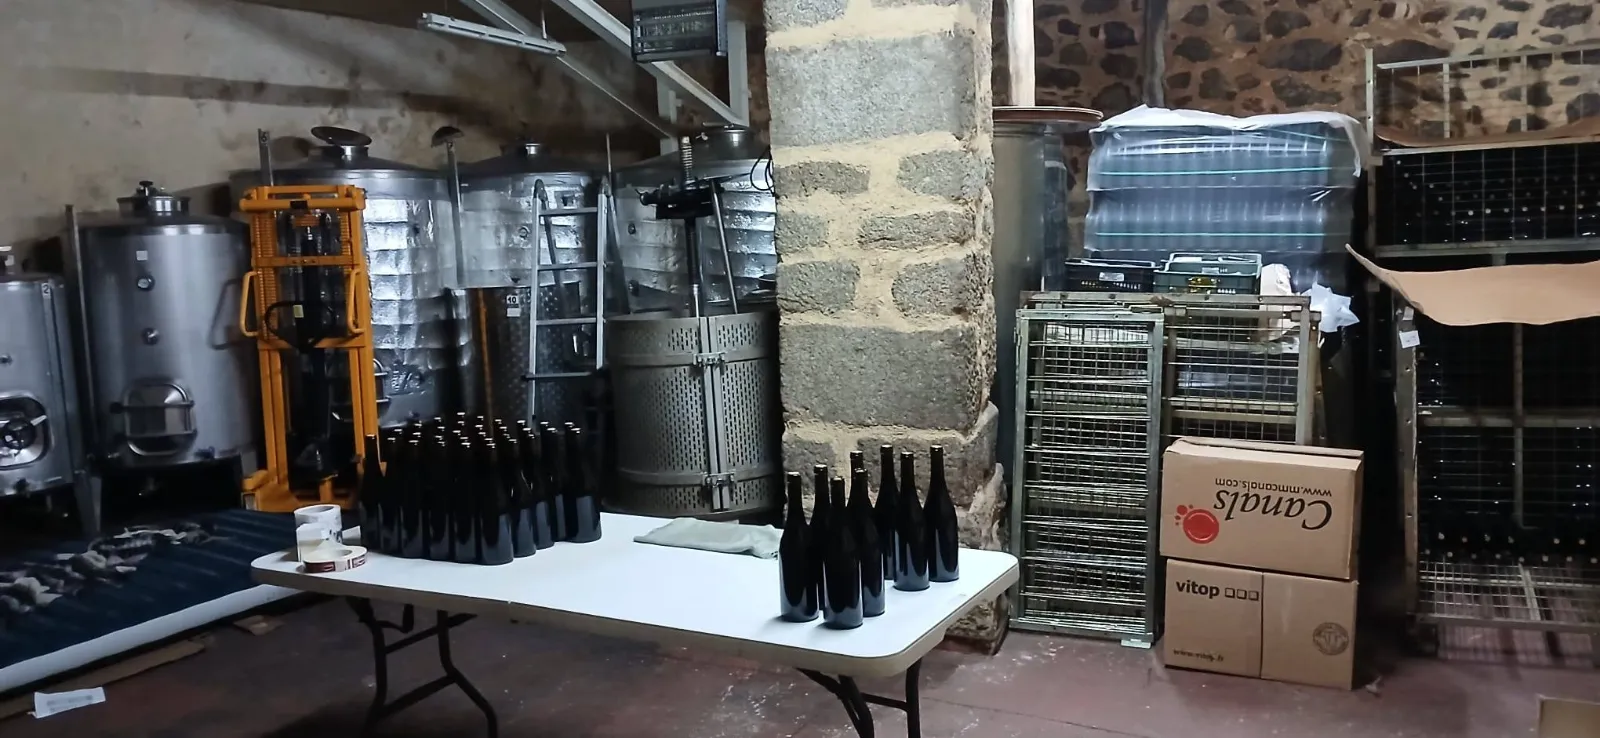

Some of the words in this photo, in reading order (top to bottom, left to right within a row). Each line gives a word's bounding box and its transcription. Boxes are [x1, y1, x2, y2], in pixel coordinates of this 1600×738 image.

[507, 296, 517, 304] 10
[1215, 478, 1332, 497] www.mmcanals.com
[1213, 490, 1333, 530] Canals
[1176, 580, 1220, 599] vitop
